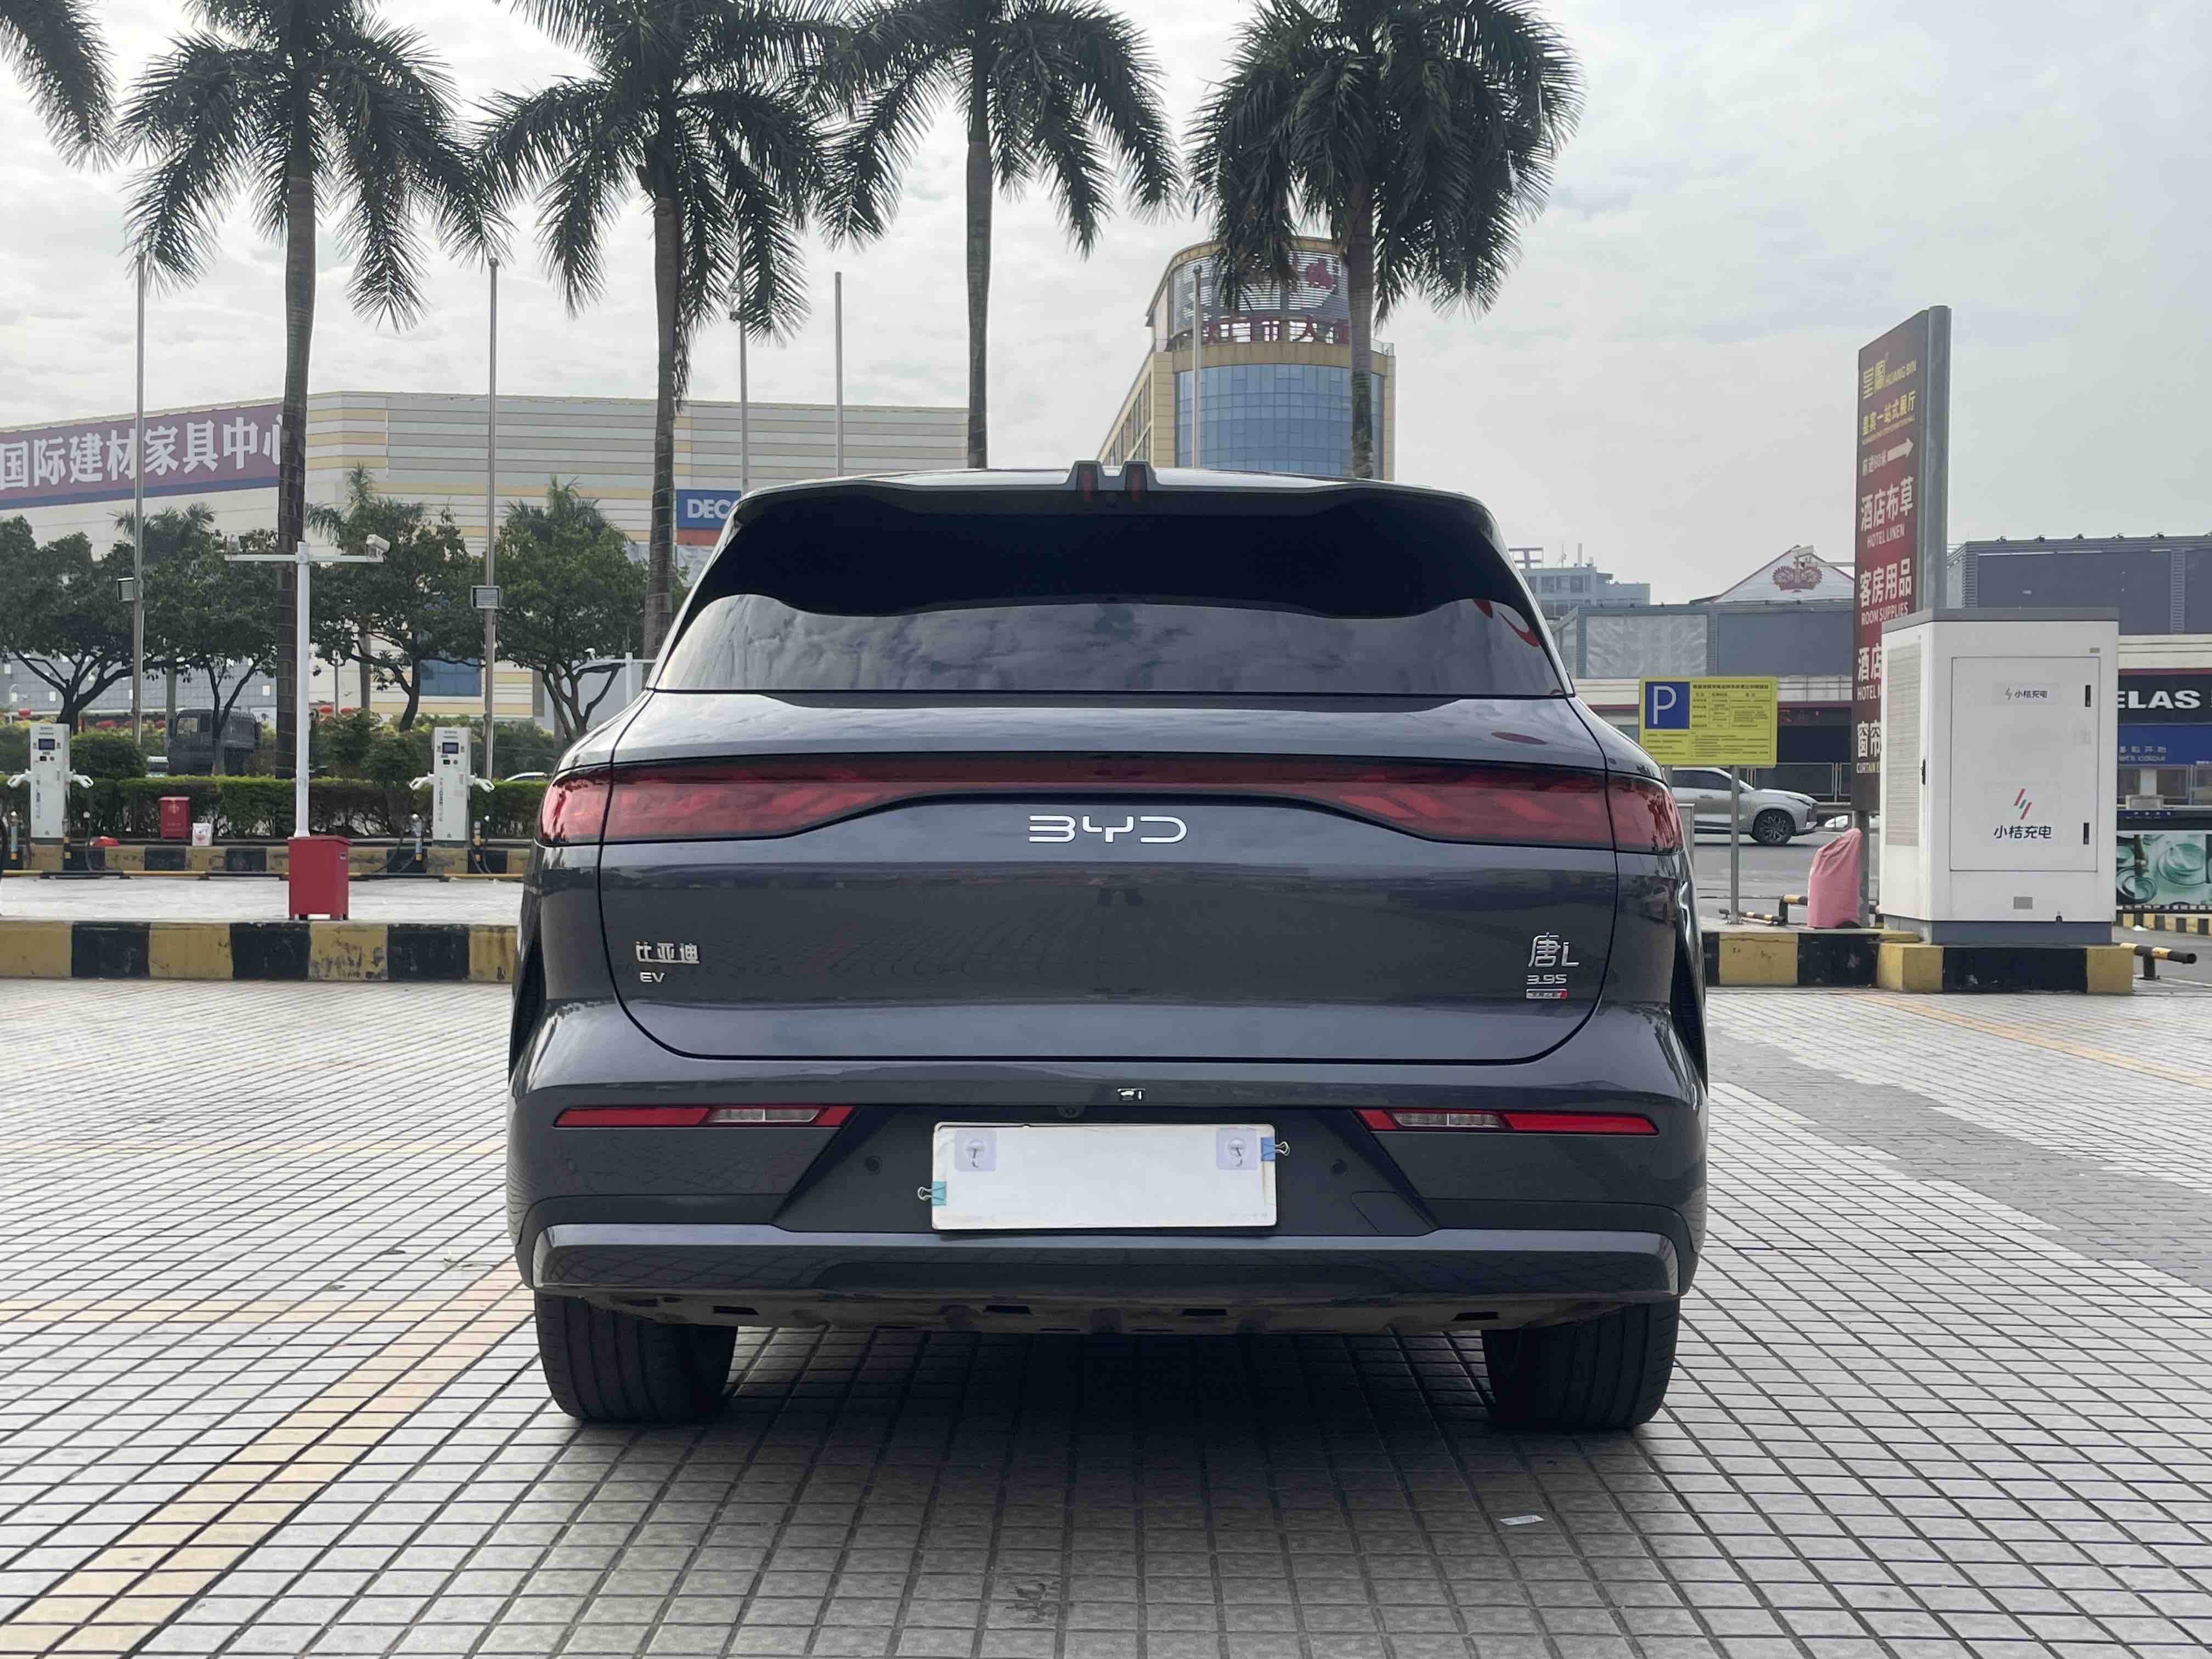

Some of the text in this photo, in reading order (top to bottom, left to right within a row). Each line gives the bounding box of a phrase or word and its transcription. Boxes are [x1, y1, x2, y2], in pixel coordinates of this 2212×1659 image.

[687, 498, 737, 519] DEC
[1861, 476, 1914, 531] 酒店布草
[1867, 522, 1905, 549] HOTEL LINEN
[1860, 557, 1912, 608] 客房用品
[1861, 601, 1909, 626] ROOM SUPPLIES
[1653, 685, 1677, 725] P
[1857, 685, 1877, 701] HOTEL
[2015, 690, 2048, 699] 小桔充电
[1029, 815, 1188, 843] BYD
[1994, 825, 2052, 839] 小桔充电
[635, 941, 700, 964] 比亚迪
[640, 972, 665, 983] EV
